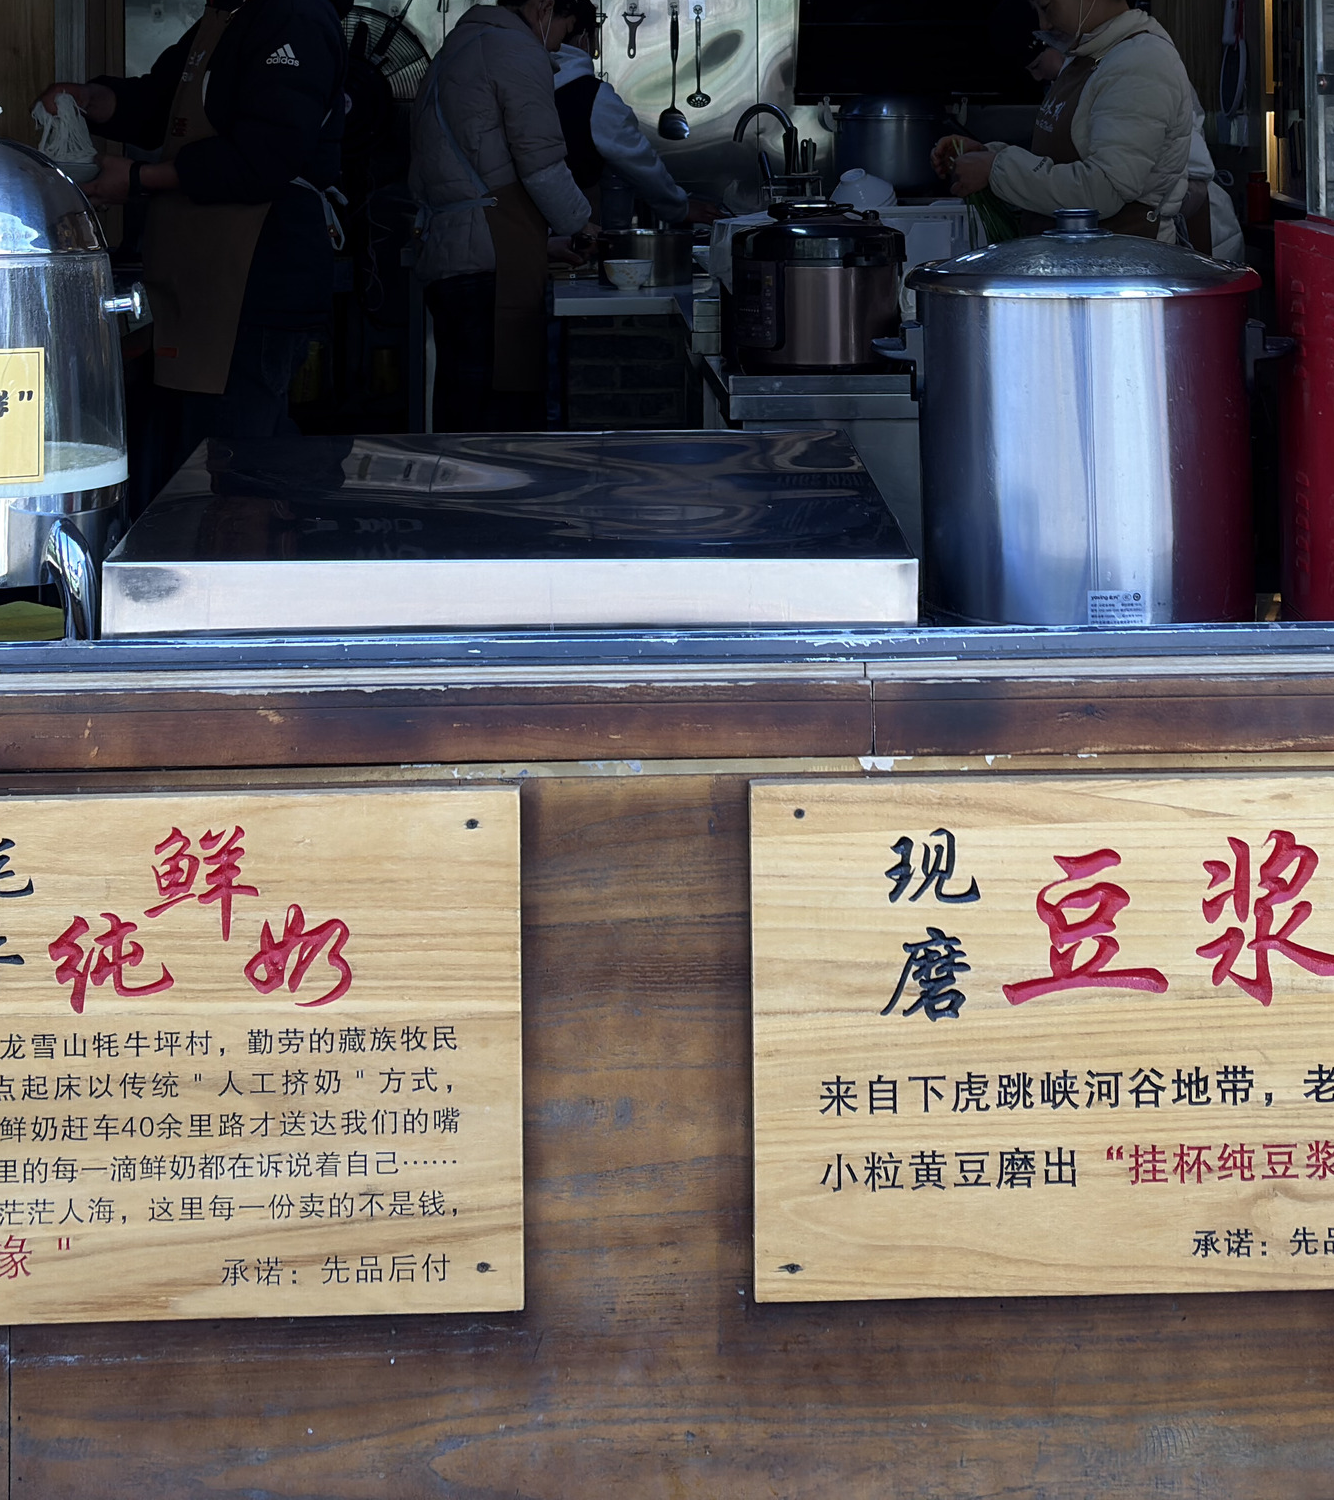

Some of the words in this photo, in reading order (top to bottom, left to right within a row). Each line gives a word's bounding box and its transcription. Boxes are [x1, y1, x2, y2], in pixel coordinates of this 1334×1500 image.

[265, 56, 300, 67] adidas
[220, 1255, 453, 1288] 承诺：先品后付
